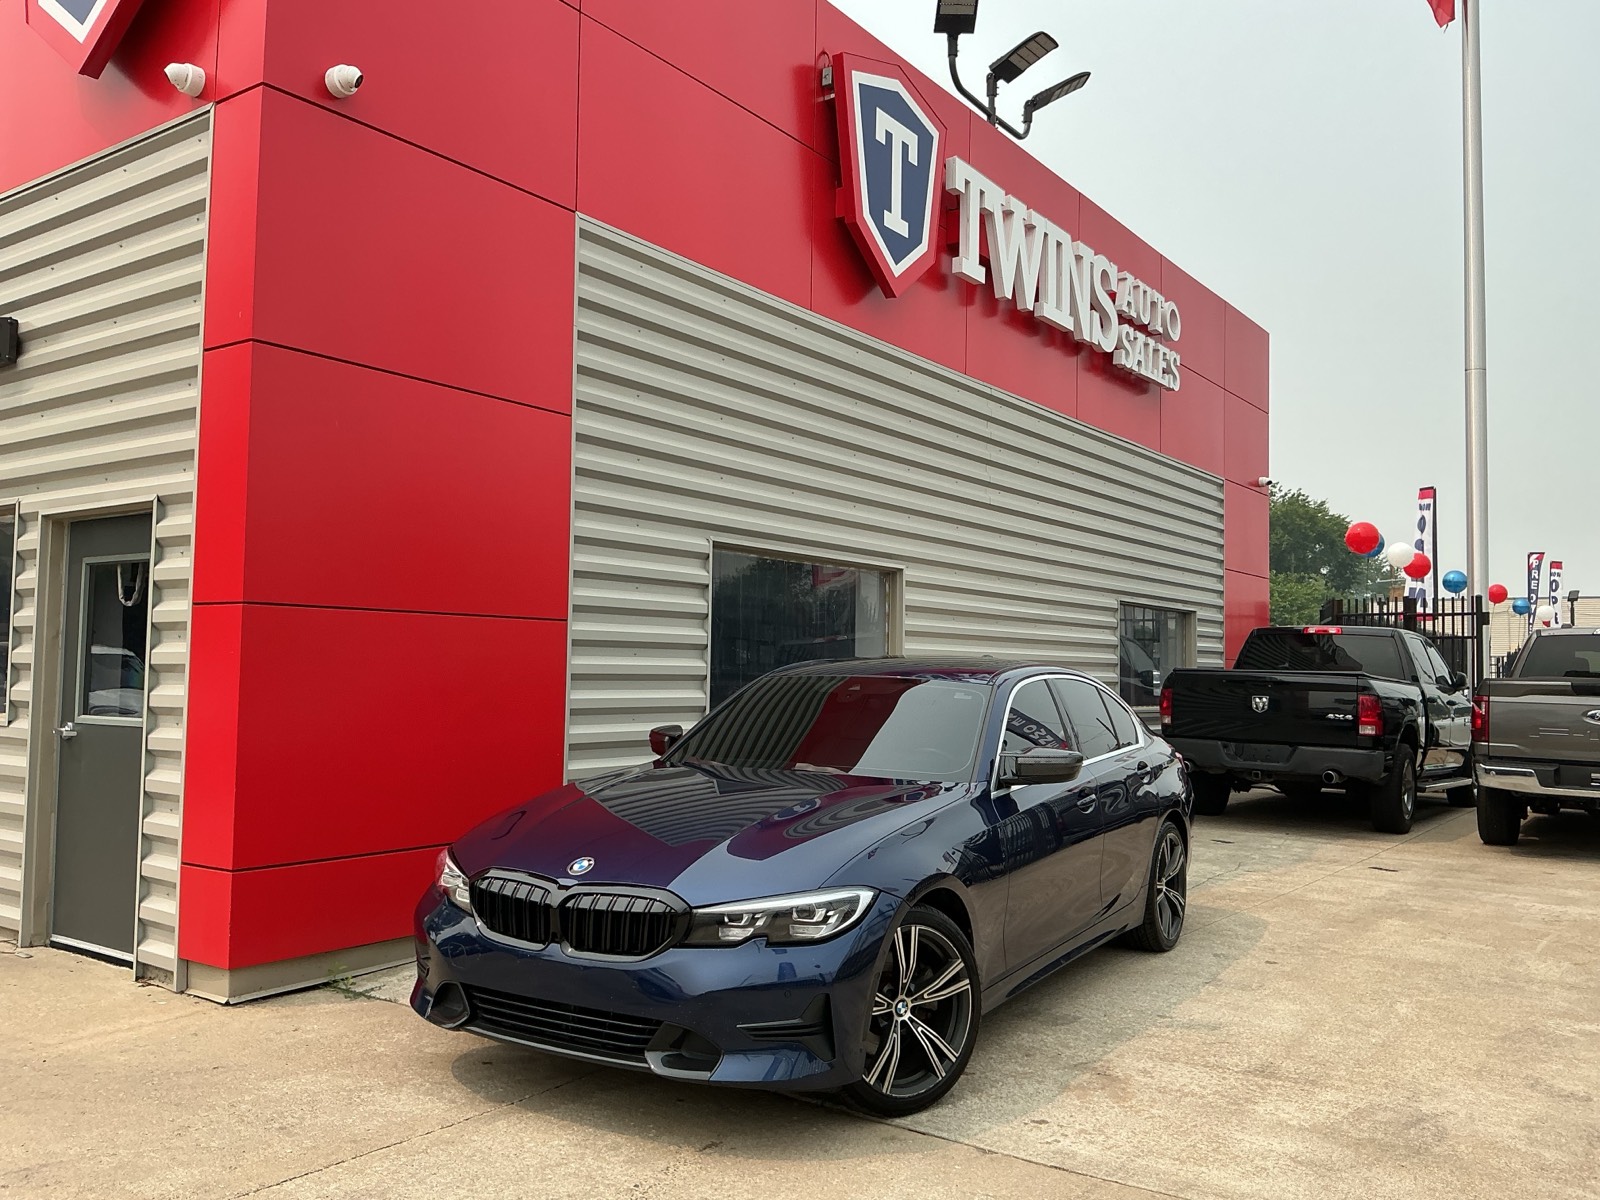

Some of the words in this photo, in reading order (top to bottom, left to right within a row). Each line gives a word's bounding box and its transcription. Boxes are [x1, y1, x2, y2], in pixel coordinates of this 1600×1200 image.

[874, 106, 918, 239] T
[945, 155, 1119, 353] TWINS
[1113, 323, 1181, 392] SALES
[1115, 271, 1181, 342] AUTO
